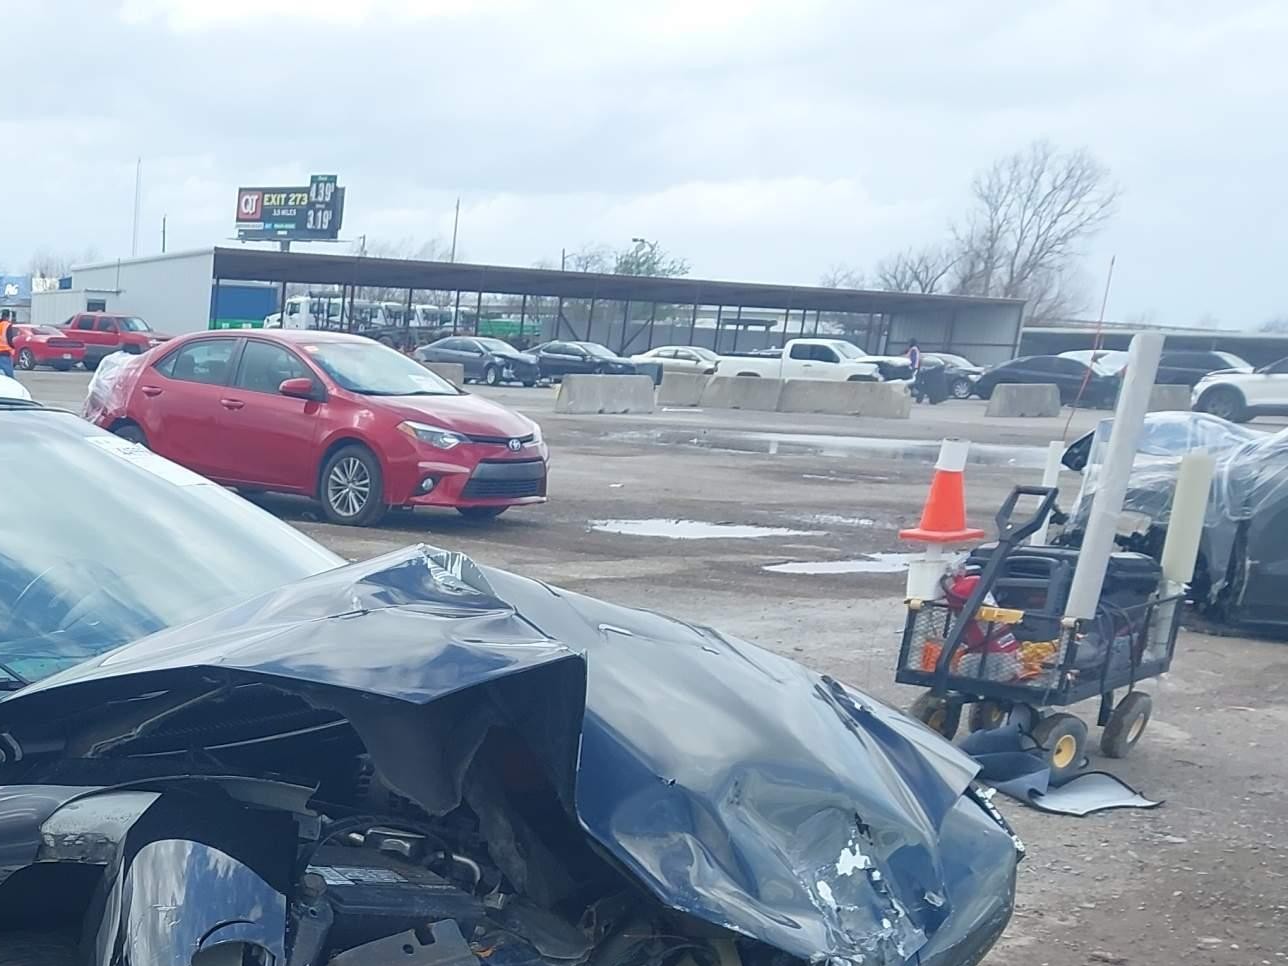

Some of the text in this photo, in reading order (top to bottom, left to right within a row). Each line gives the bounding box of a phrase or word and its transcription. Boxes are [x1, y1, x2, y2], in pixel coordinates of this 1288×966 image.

[242, 195, 258, 214] QT
[264, 194, 308, 205] EXIT 273
